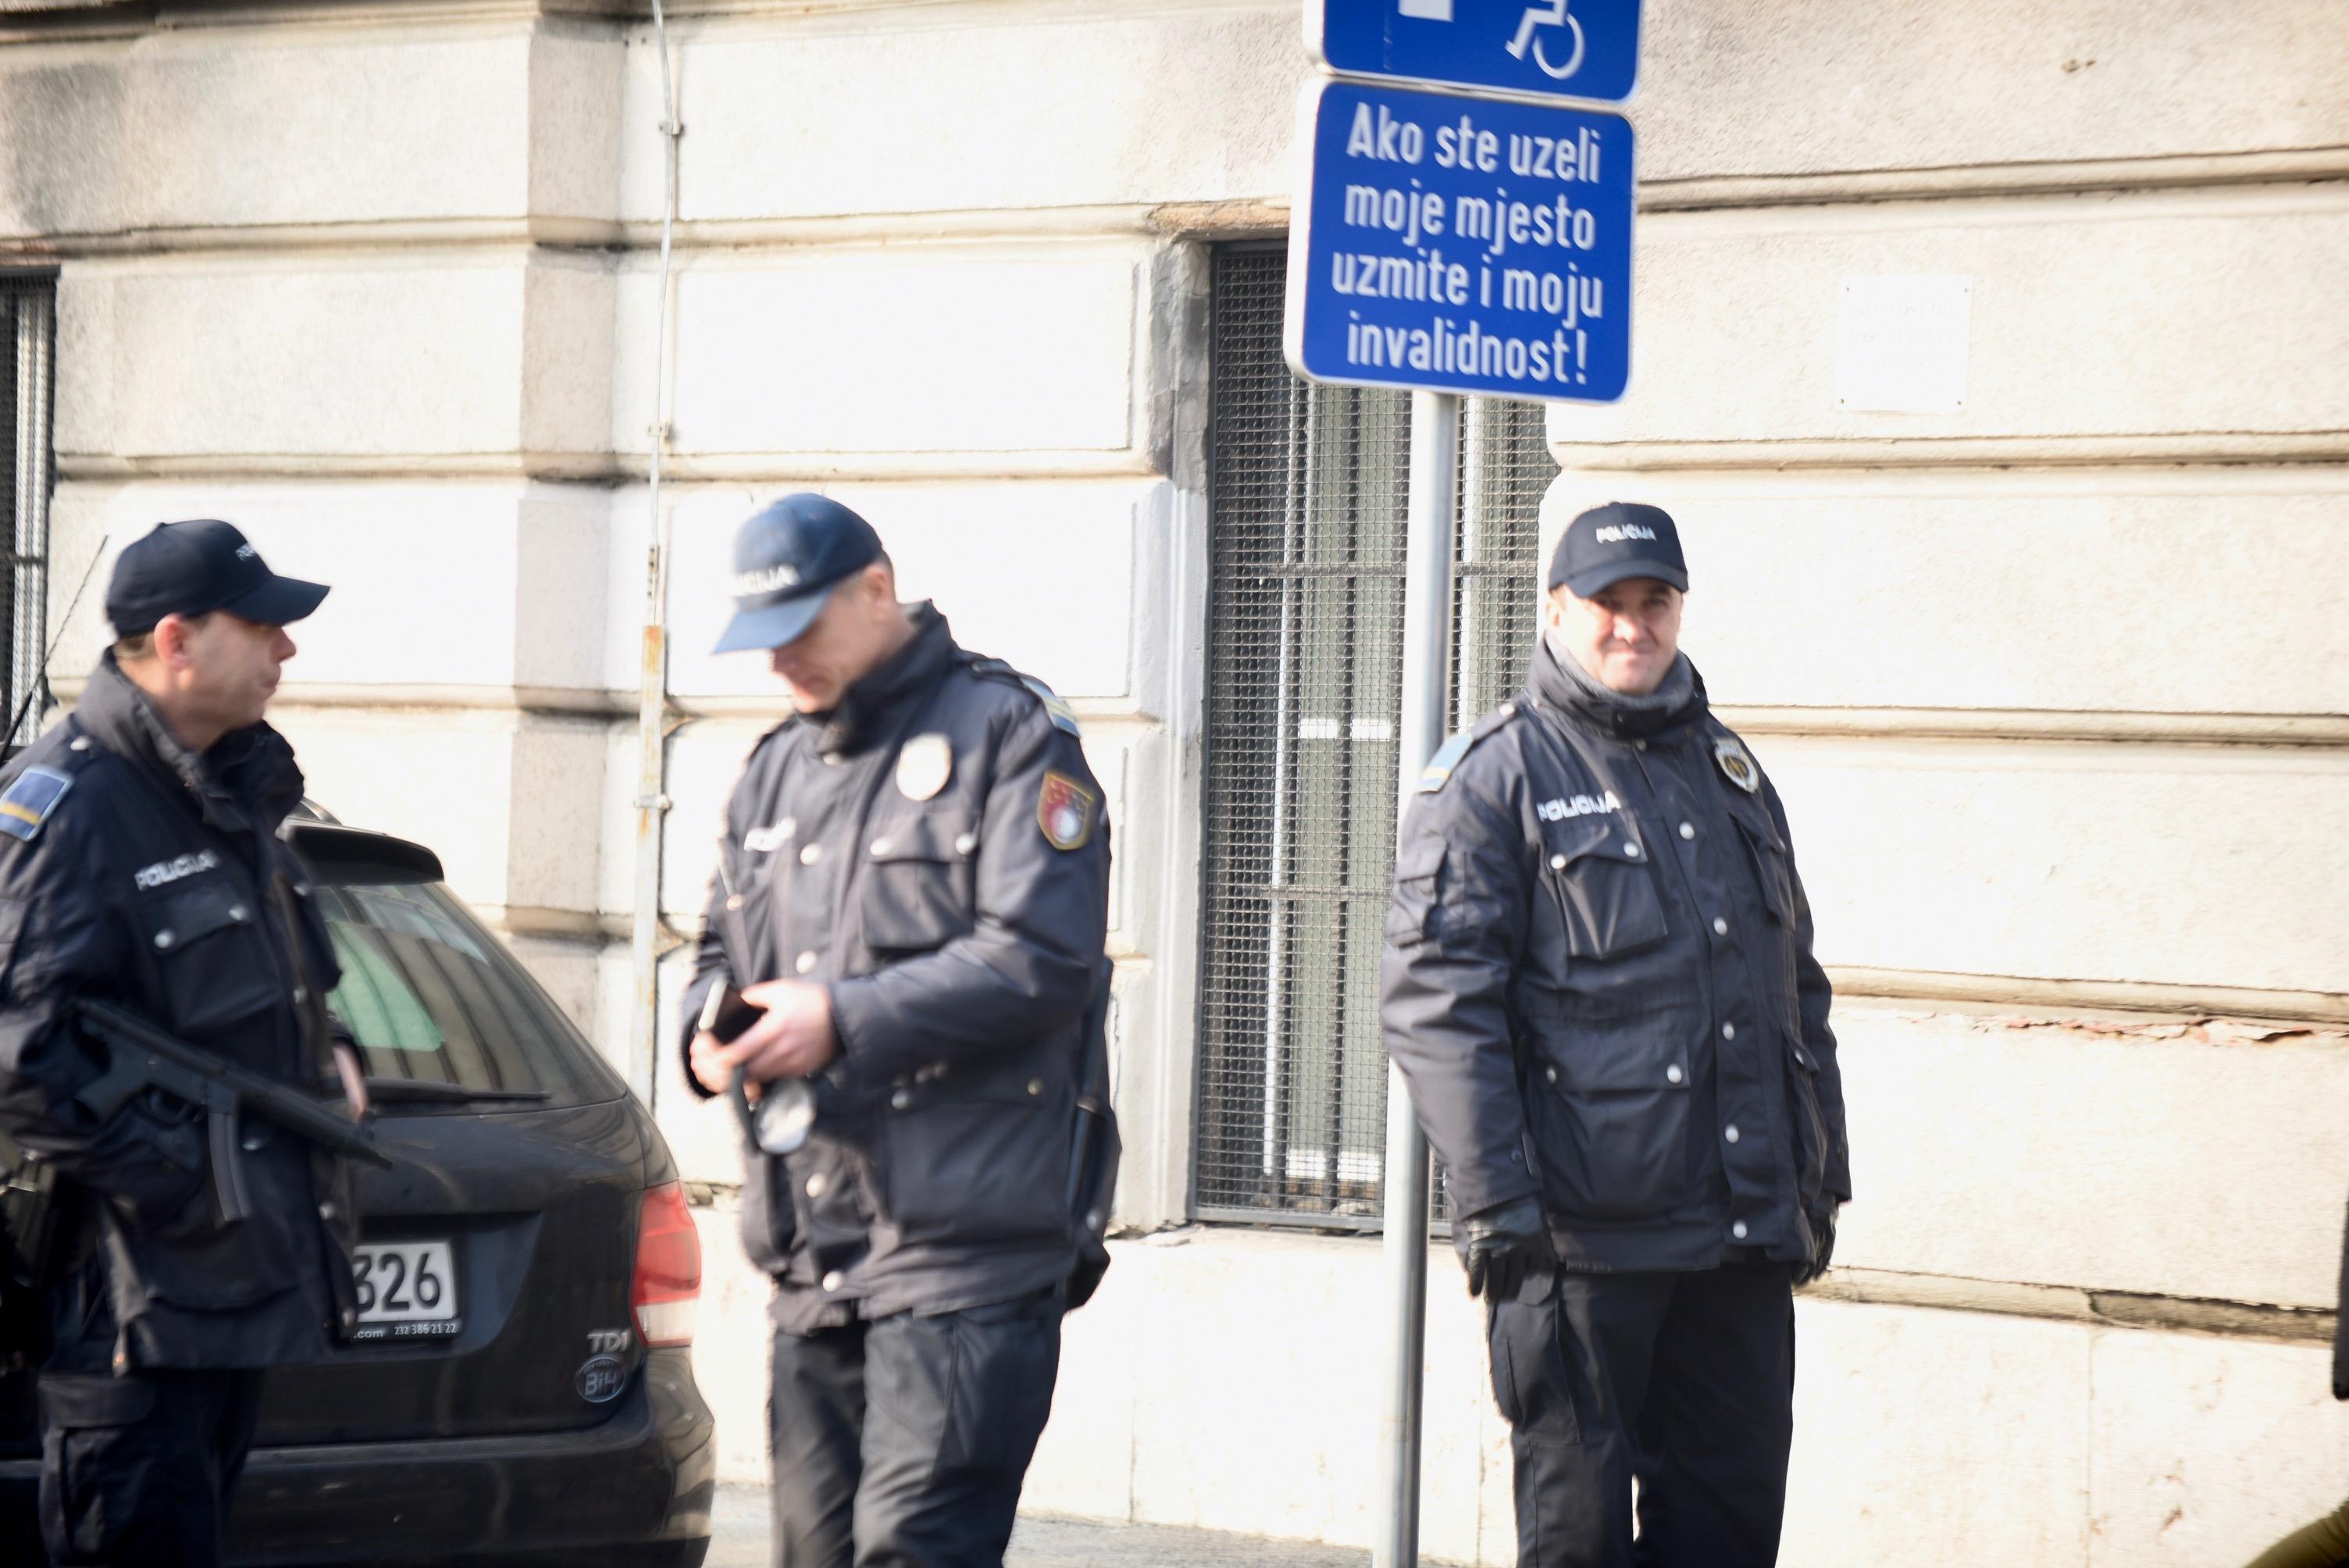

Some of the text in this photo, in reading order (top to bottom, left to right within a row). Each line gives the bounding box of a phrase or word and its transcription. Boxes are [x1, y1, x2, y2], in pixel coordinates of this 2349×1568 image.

[1346, 102, 1602, 184] Ako ste uzeli
[1344, 178, 1595, 256] moje mjesto
[1331, 248, 1604, 330] uzmite i moju
[1347, 310, 1587, 386] invalidnost!
[353, 1253, 440, 1313] 326
[586, 1328, 631, 1353] TDI
